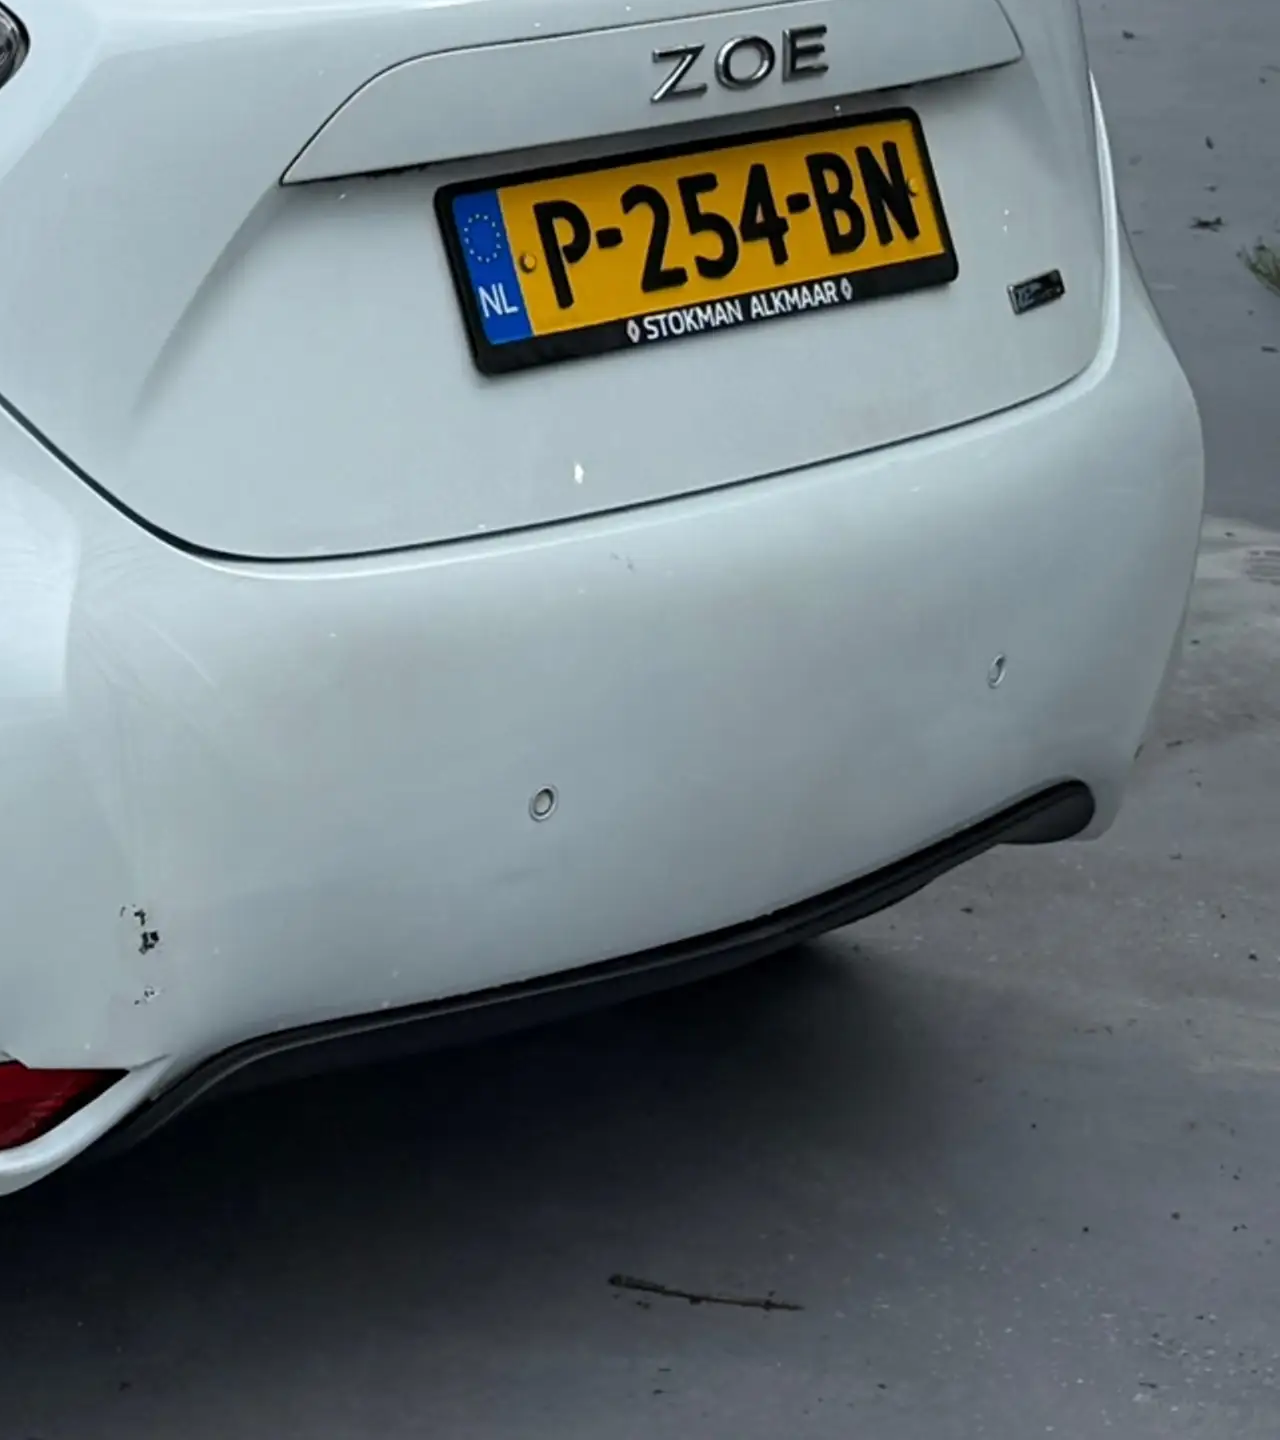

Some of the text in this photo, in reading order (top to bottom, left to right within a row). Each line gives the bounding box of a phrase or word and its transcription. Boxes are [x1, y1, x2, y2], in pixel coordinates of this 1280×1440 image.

[650, 24, 829, 103] ZOE
[533, 141, 920, 309] P-254-BN
[478, 283, 519, 319] NL
[643, 281, 839, 341] STOKMAN ALKMAAR
